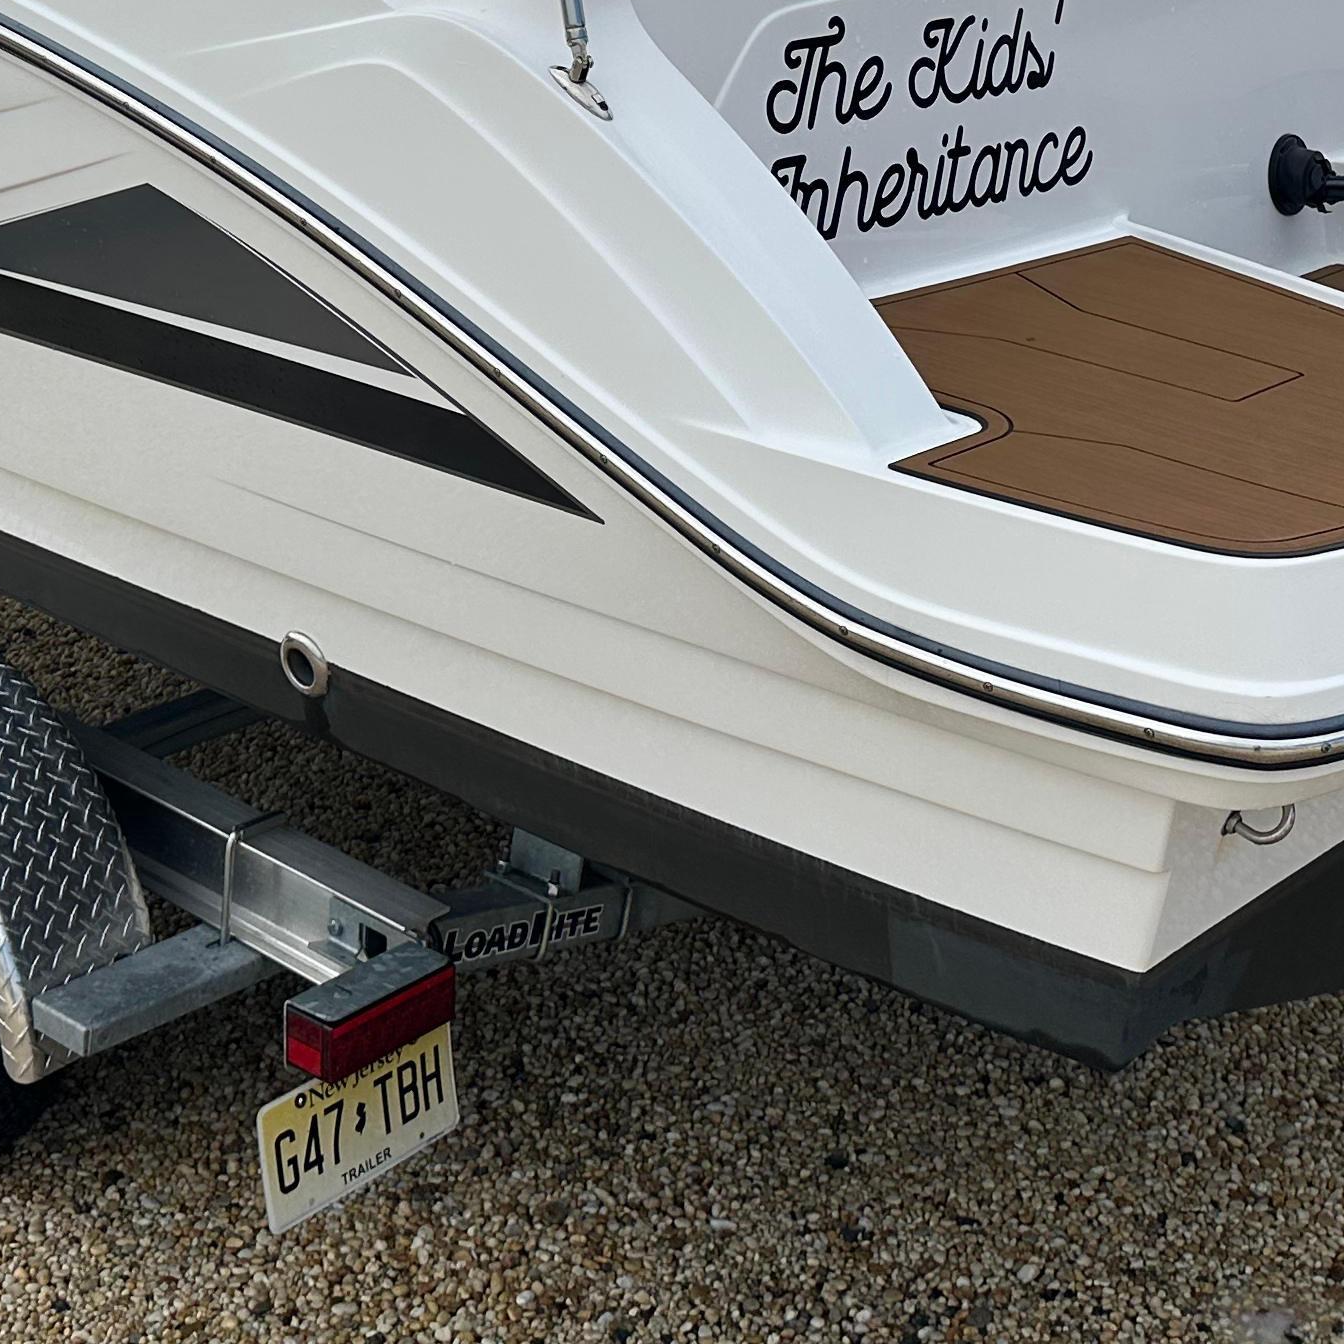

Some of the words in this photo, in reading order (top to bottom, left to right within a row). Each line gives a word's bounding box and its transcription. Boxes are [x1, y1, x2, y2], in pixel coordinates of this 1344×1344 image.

[766, 16, 892, 134] The
[274, 1098, 346, 1195] G47
[373, 1044, 444, 1136] TBH
[306, 1076, 352, 1108] New
[341, 1146, 392, 1186] TRAILER
